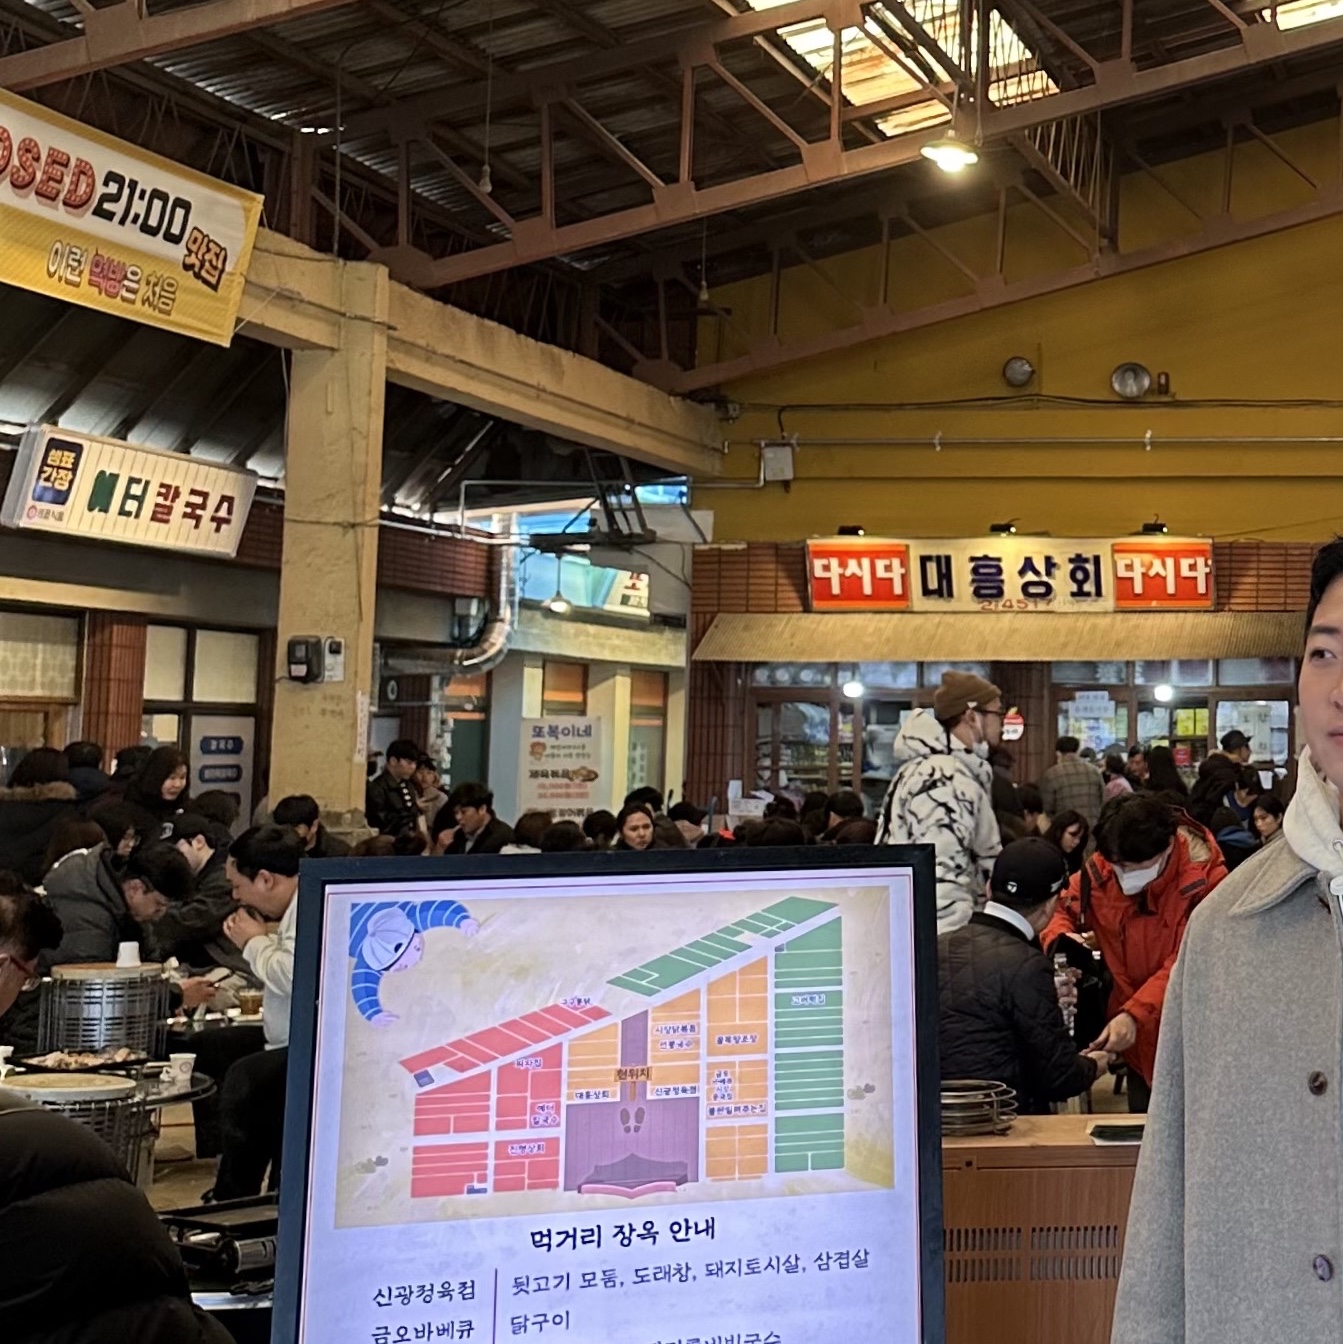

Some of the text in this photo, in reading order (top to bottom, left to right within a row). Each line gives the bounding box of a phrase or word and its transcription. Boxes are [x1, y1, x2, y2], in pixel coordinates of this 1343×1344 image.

[91, 170, 192, 245] 21:00
[47, 239, 88, 287] 이런
[141, 271, 179, 316] 처음
[182, 226, 228, 293] 맛집
[812, 556, 906, 596] 다시다
[1115, 556, 1212, 596] 다시다
[531, 723, 593, 741] 또복이네
[616, 1066, 650, 1082] 현위치
[529, 1216, 716, 1253] 먹거리 장옥 안내
[512, 1271, 571, 1297] 뒷고기
[578, 1268, 625, 1289] 모둠,
[631, 1261, 697, 1285] 도래창,
[813, 1248, 870, 1272] 삼겹살
[372, 1279, 476, 1308] 신광정육점
[510, 1309, 570, 1336] 닭구이
